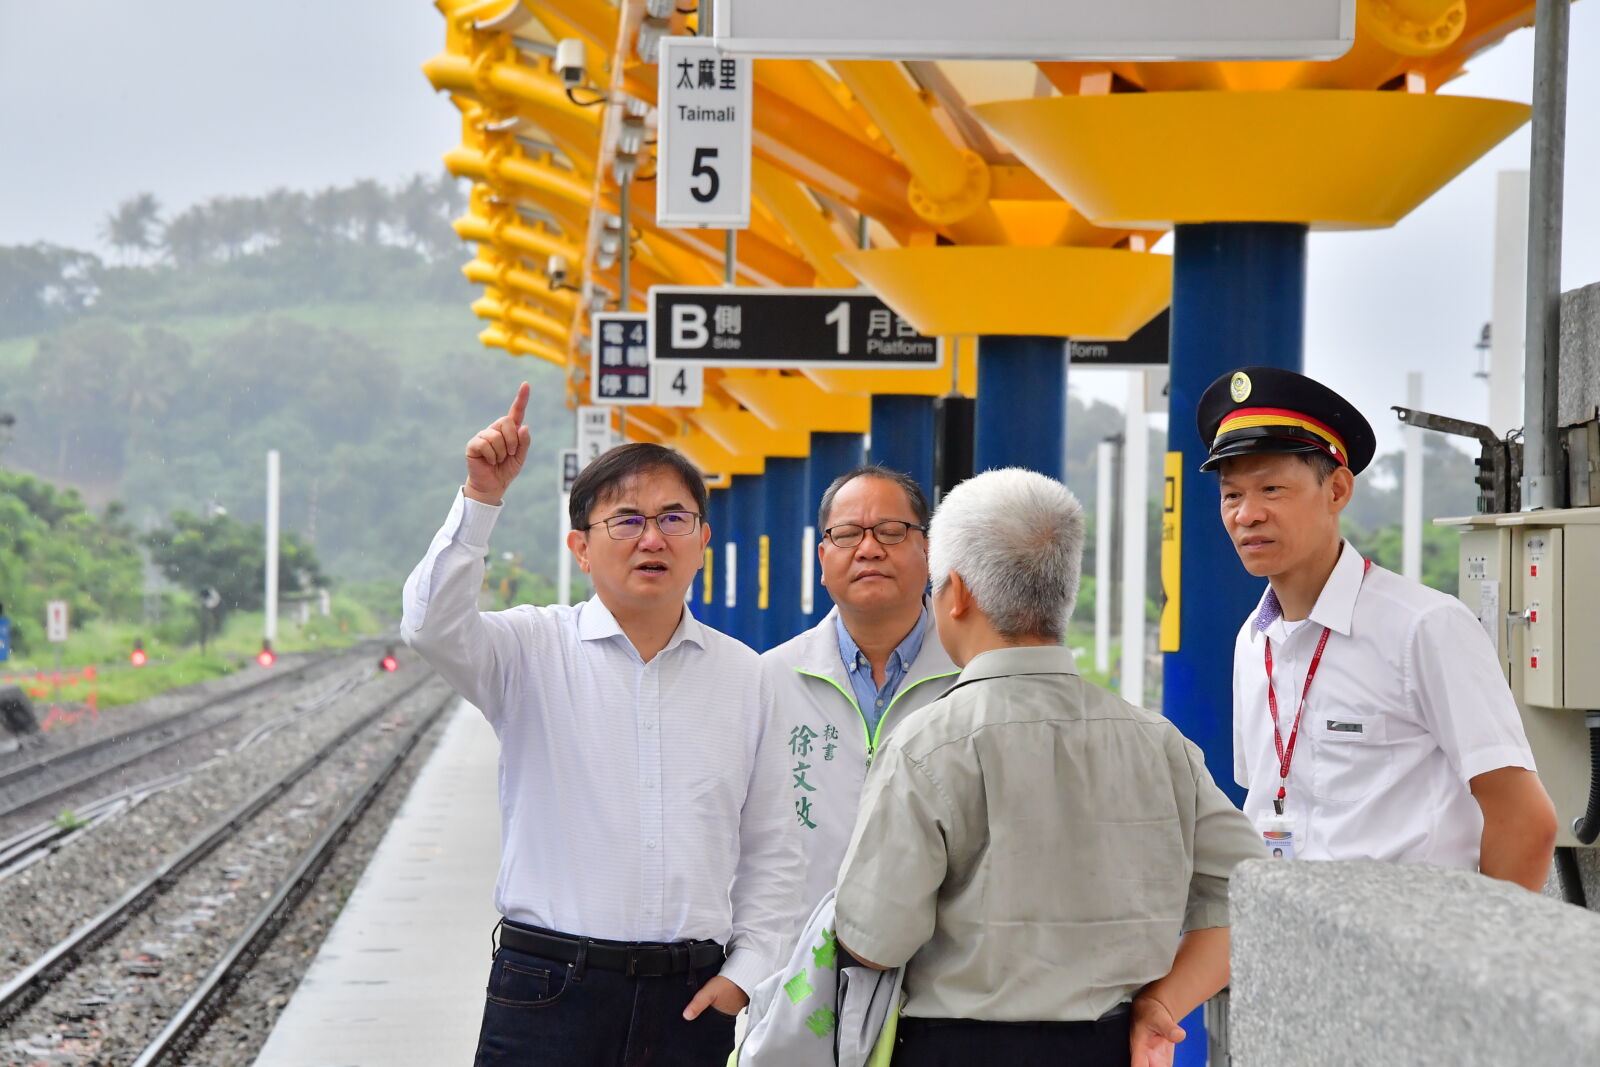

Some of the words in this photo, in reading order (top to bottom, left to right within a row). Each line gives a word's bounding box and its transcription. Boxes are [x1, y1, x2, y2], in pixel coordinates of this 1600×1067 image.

[676, 58, 737, 91] 太麻里
[678, 105, 735, 122] Taimali
[690, 147, 720, 203] 5
[671, 303, 709, 349] B
[713, 305, 741, 334] 側
[825, 301, 850, 354] 1
[866, 338, 933, 355] Platform
[671, 367, 688, 396] 4
[821, 723, 839, 762] 秘書
